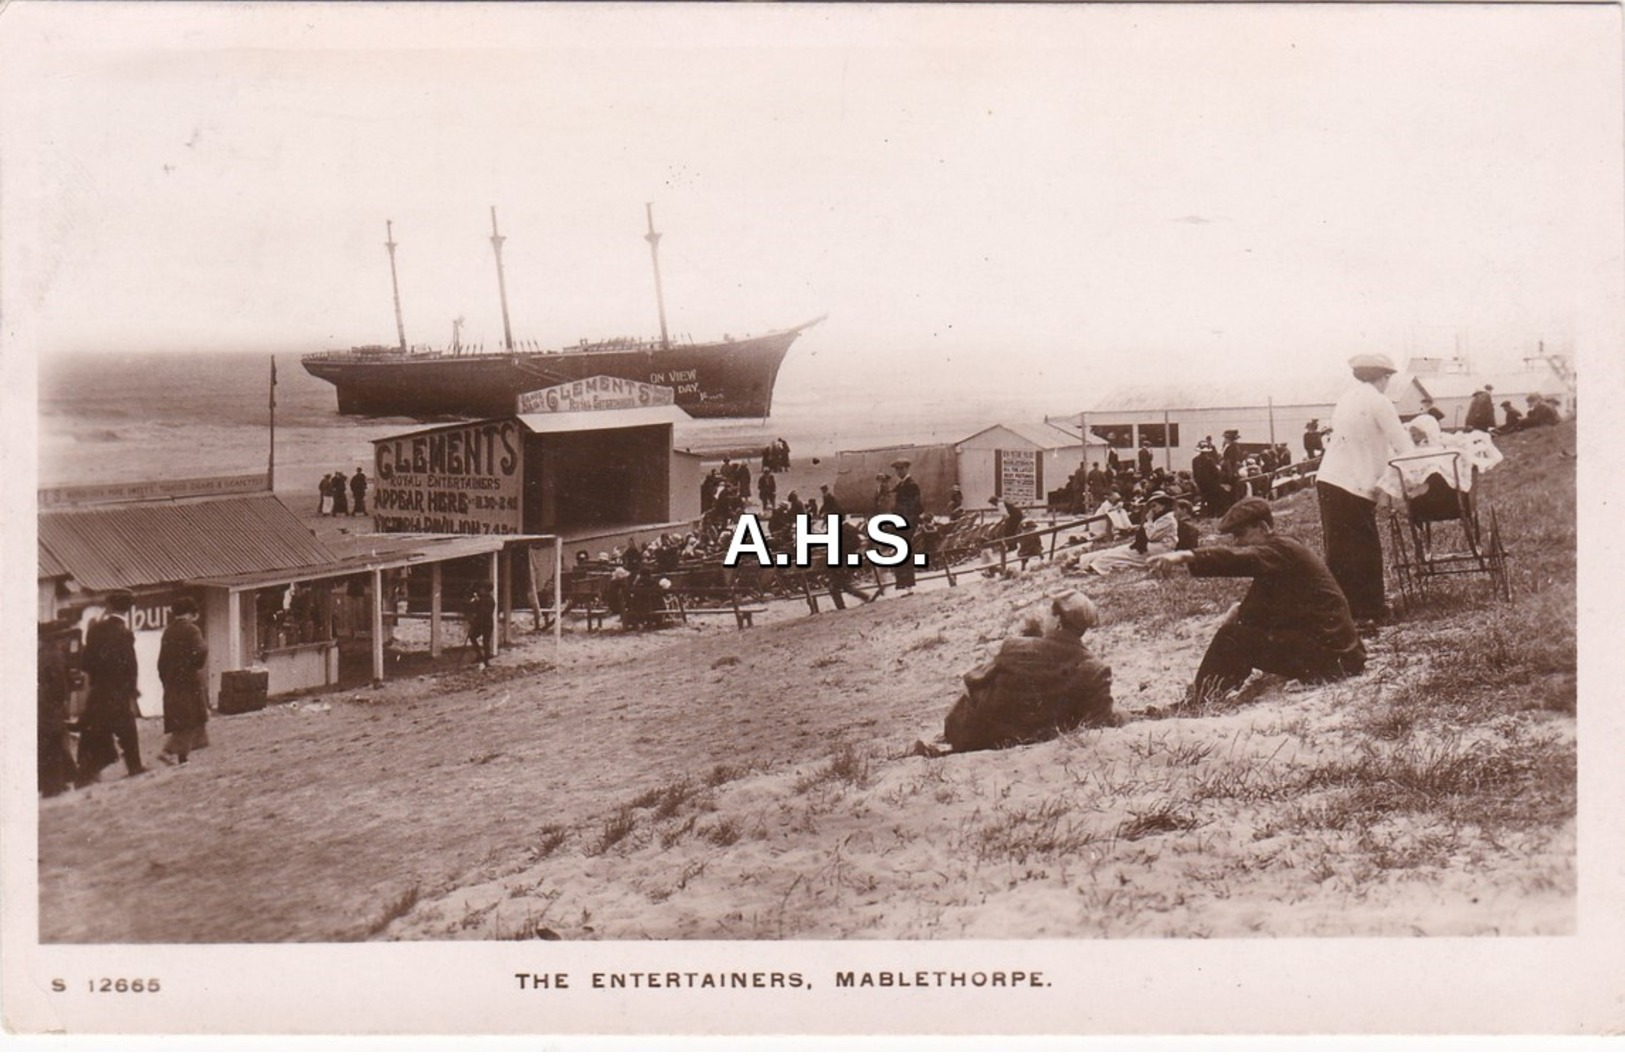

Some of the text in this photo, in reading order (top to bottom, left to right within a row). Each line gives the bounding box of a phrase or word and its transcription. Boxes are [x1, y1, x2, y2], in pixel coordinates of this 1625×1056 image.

[650, 368, 697, 384] ON VIEW
[546, 379, 649, 411] CLEMENTS
[376, 422, 518, 480] CLEMENTS
[390, 475, 501, 490] ROYAL ENTERTAINERS
[374, 488, 425, 513] APPEAR
